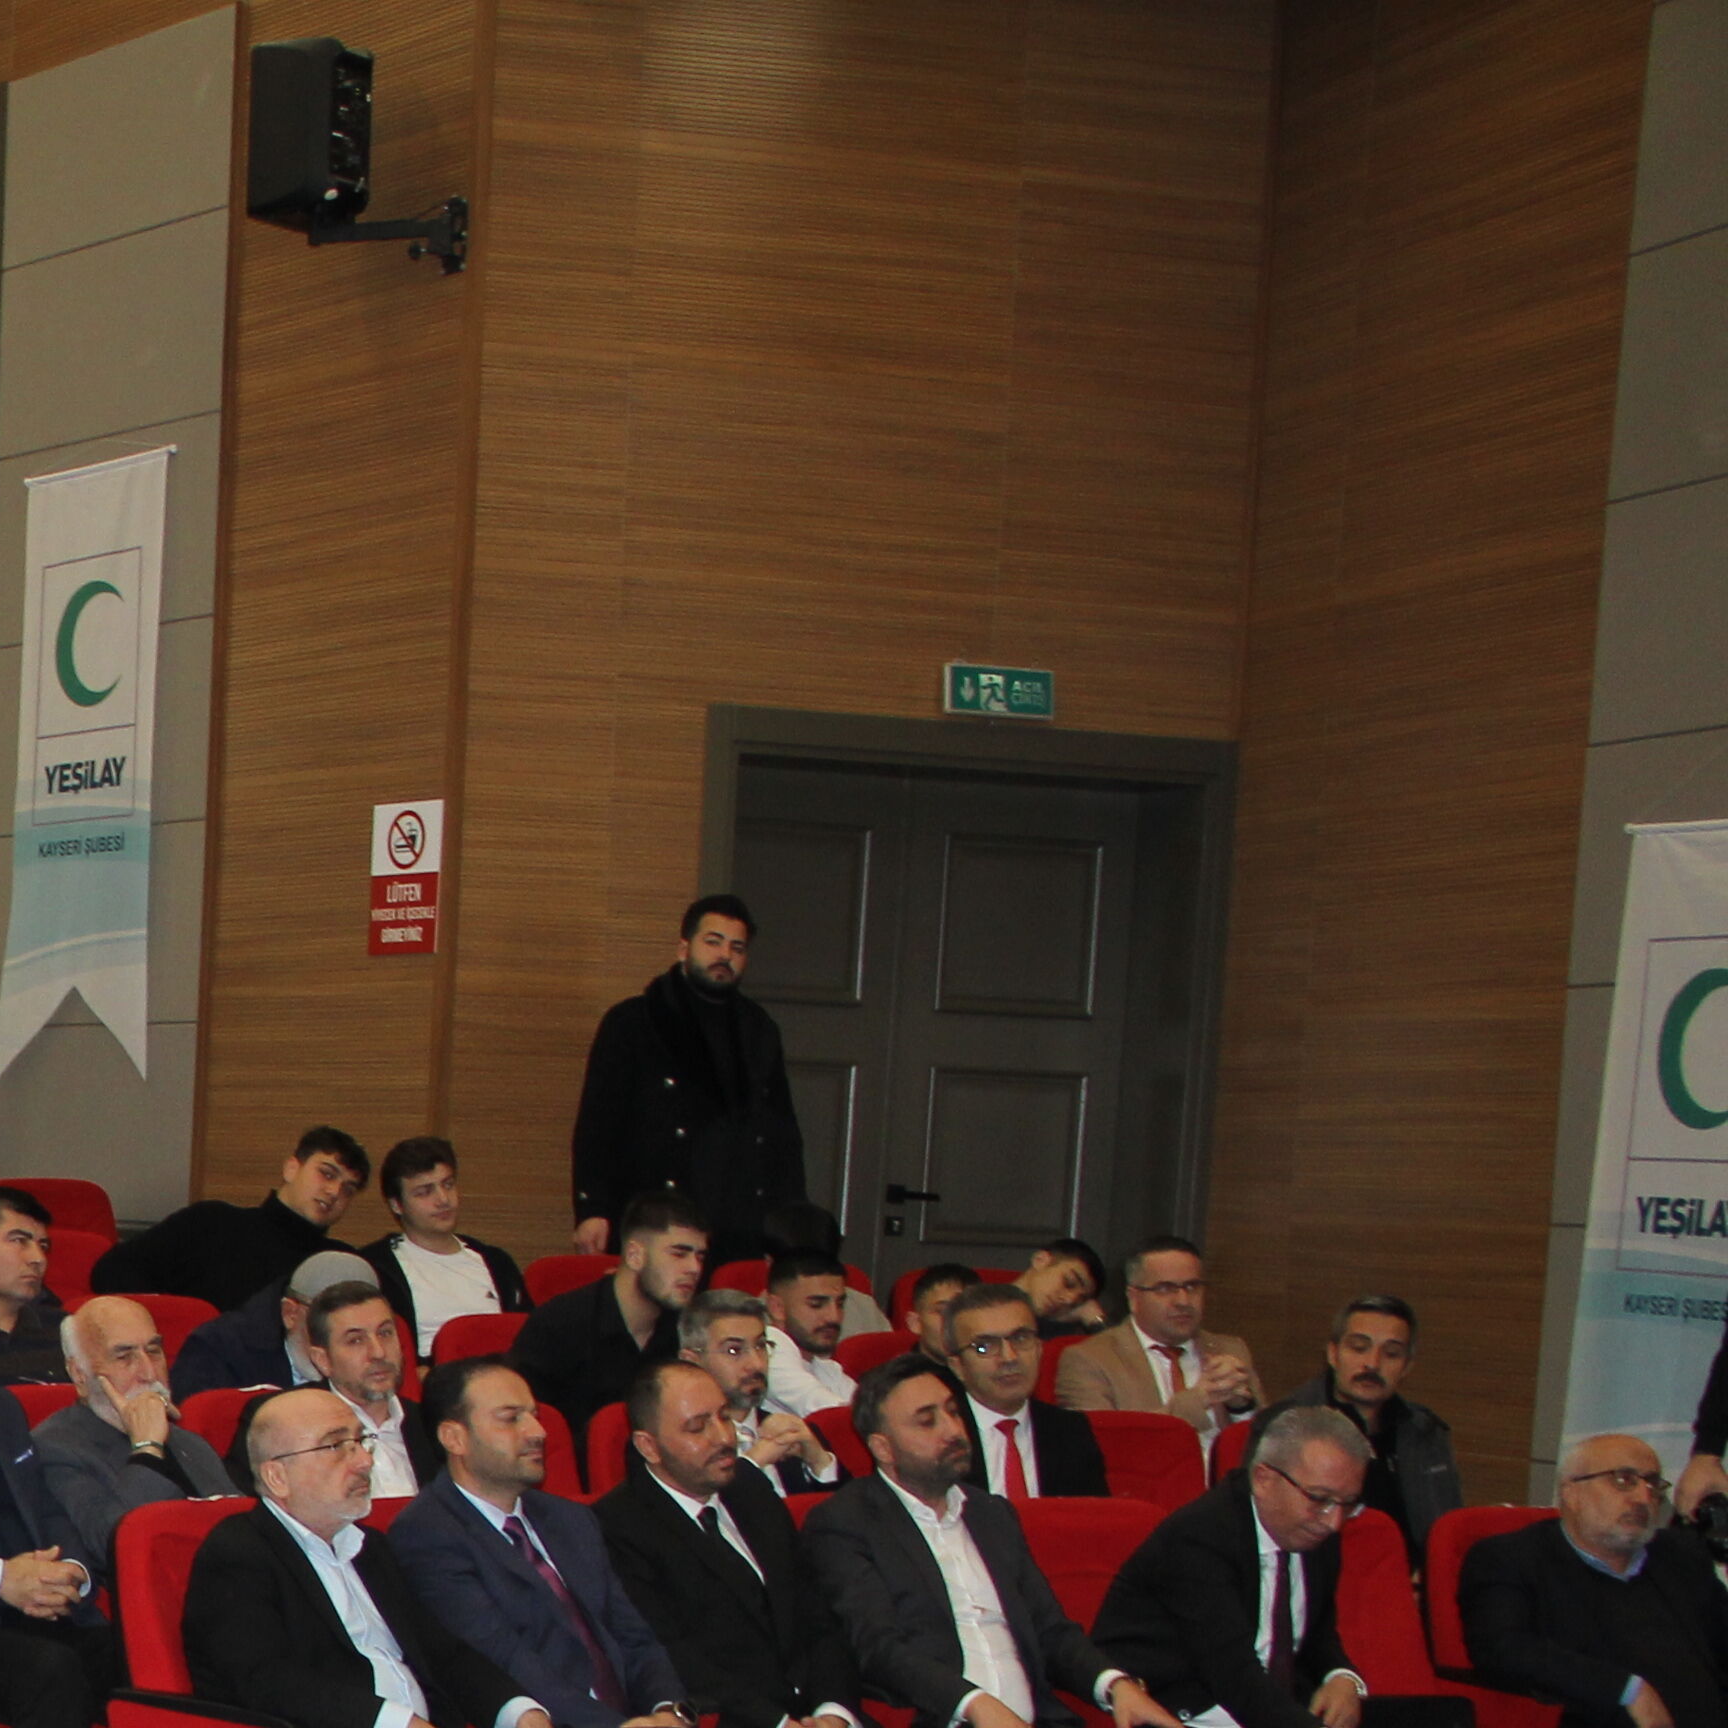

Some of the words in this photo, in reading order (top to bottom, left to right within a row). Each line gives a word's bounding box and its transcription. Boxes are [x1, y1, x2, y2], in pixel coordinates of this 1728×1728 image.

[38, 836, 82, 857] KAYSERİ
[85, 832, 125, 857] ŞUBESİ
[1636, 1196, 1728, 1239] YEŞİLA
